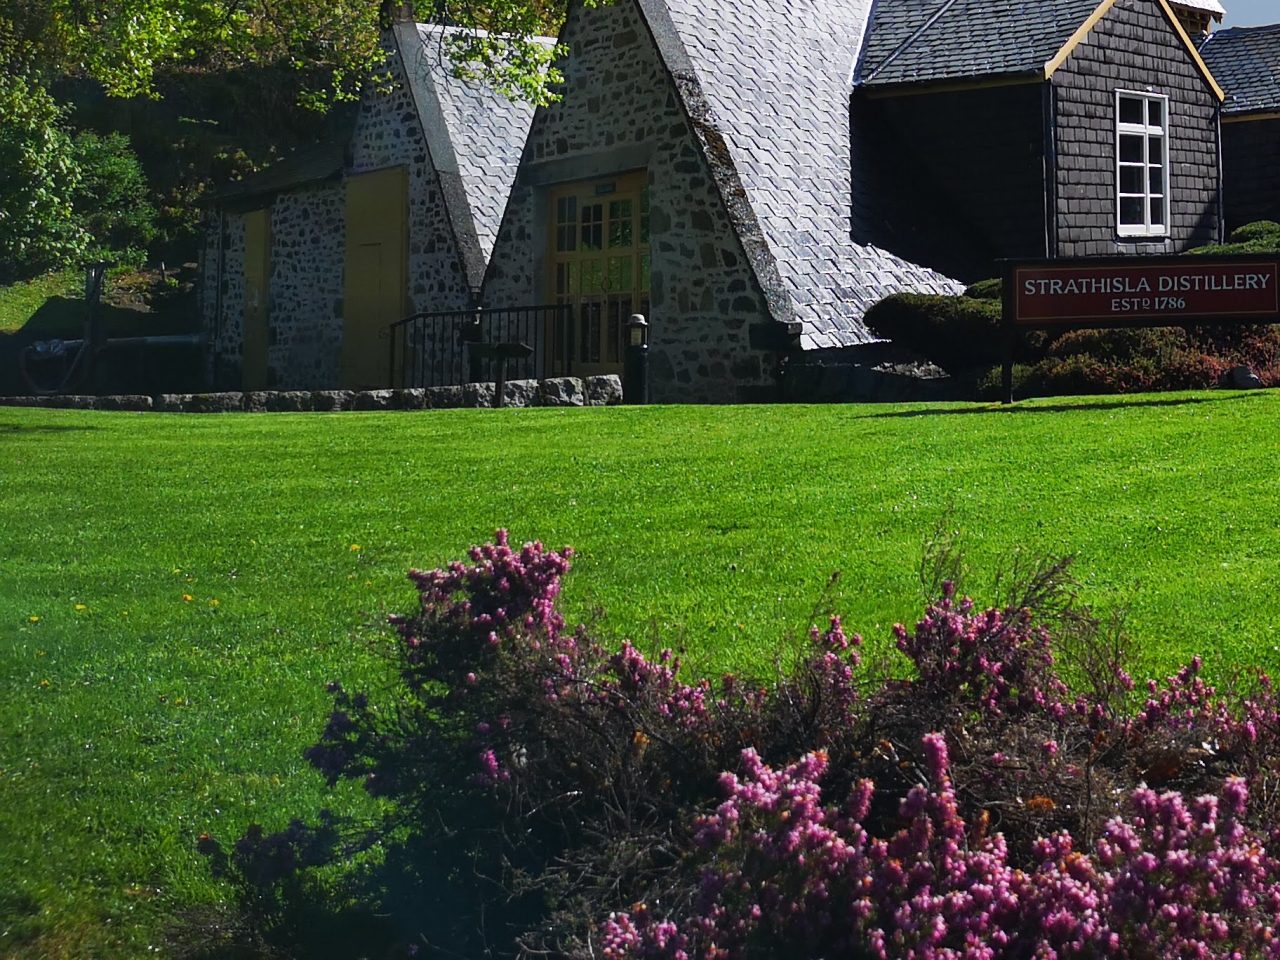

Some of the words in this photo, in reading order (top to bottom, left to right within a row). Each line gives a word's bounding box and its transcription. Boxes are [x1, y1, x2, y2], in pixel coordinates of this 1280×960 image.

[1024, 277, 1151, 295] STRATHISLA
[1158, 274, 1270, 292] DISTILLERY
[1153, 296, 1186, 310] 1786
